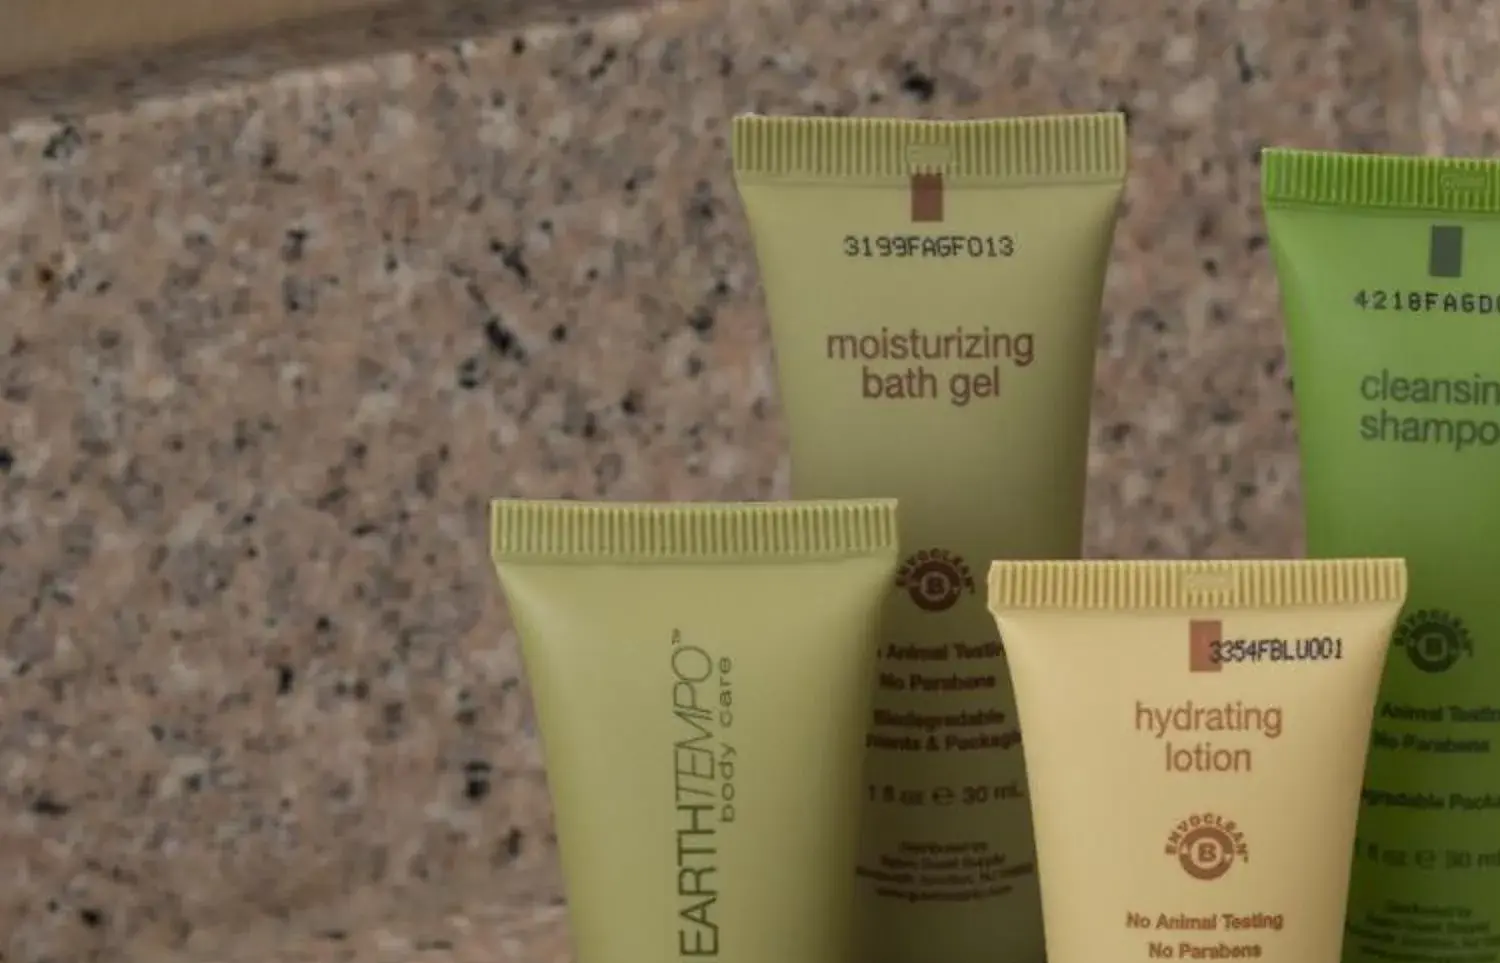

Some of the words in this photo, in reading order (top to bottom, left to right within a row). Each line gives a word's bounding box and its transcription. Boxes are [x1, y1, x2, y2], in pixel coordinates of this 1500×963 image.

[826, 326, 1034, 366] moisturizing
[861, 366, 937, 400] bath
[949, 366, 1001, 407] gel
[718, 656, 734, 728] care
[1135, 699, 1283, 738] hydrating
[1165, 740, 1252, 772] lotion
[717, 742, 737, 822] body
[1126, 911, 1150, 930] No
[1156, 913, 1217, 931] Animal
[1222, 912, 1284, 931] Testing
[1149, 941, 1172, 959] No
[1178, 942, 1262, 960] Parabens
